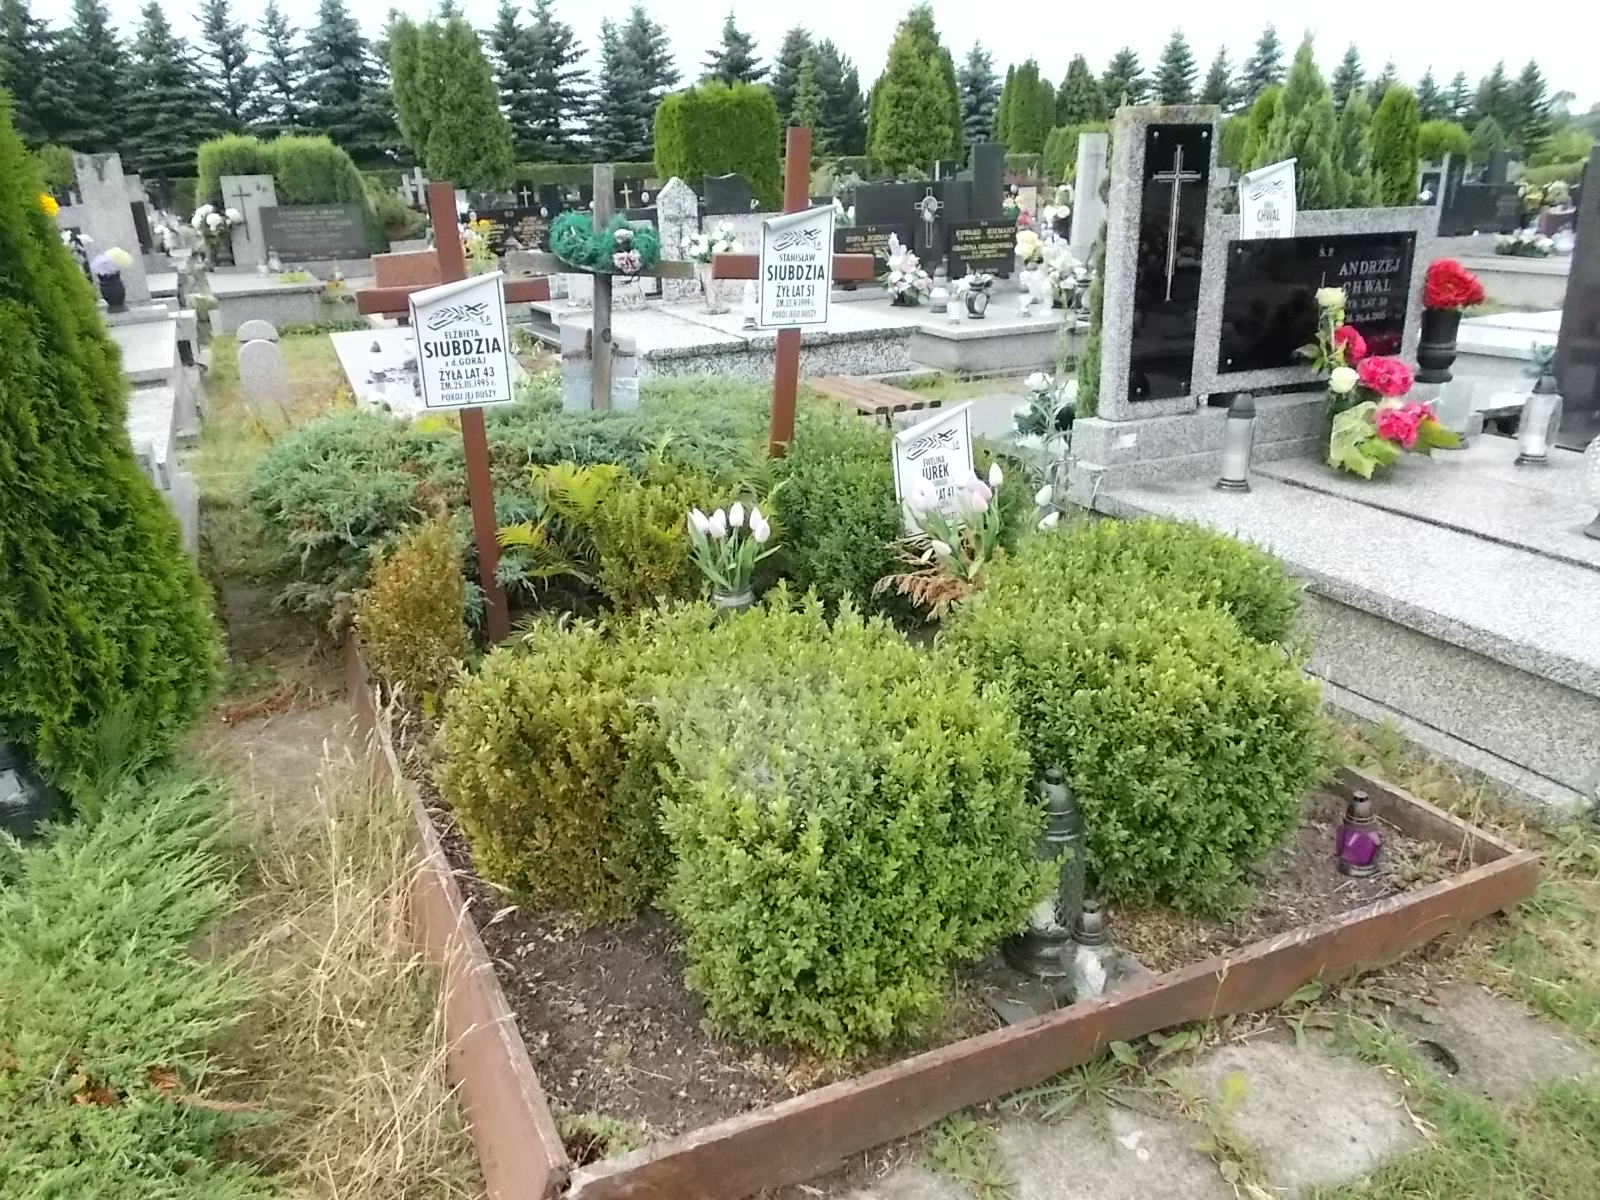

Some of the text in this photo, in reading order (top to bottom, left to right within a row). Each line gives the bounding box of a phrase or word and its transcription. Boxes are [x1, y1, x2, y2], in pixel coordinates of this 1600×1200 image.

[779, 253, 816, 262] STANISŁAW
[767, 264, 825, 281] SIUBDZIA
[1339, 258, 1401, 276] ANDRZEJ
[776, 282, 790, 298] ŻYŁ
[792, 285, 805, 297] LAT
[1342, 278, 1392, 294] CHWAL
[444, 328, 480, 340] ELŻBIETA
[424, 337, 502, 359] SIUBDZIA
[438, 366, 495, 382] ŻYŁA LAT 43
[475, 389, 496, 399] DUSZY
[923, 455, 945, 467] EWELINA
[936, 487, 946, 501] AT
